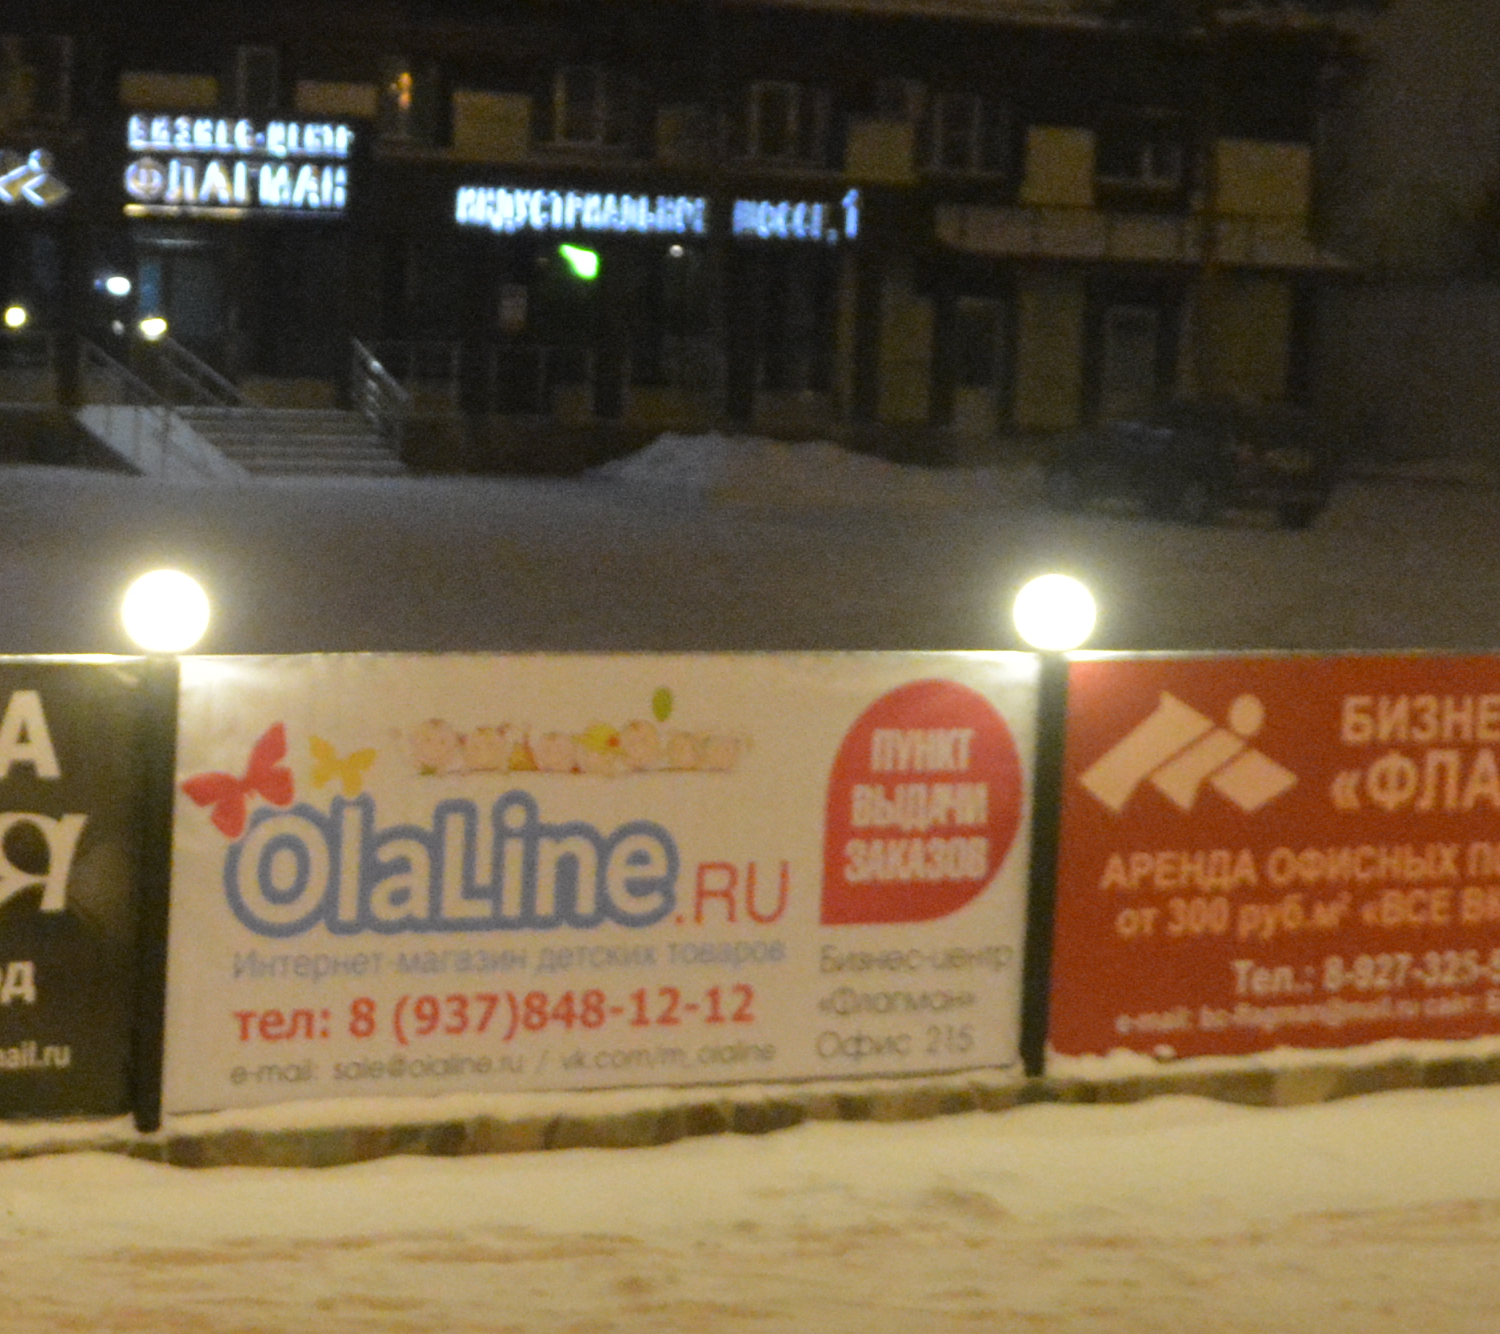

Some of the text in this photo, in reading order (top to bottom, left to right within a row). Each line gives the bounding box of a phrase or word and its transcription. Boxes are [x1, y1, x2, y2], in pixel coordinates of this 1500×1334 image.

[870, 727, 974, 772] ПУНКТ
[850, 781, 990, 831] ВЫДАЧИ
[843, 836, 990, 883] ЗАКАЗОВ
[1099, 849, 1261, 891] АРЕНДА
[1267, 843, 1460, 886] ОФИСНЫХ
[1115, 905, 1161, 938] от
[535, 945, 656, 975] детских
[666, 940, 786, 973] товаров
[231, 983, 756, 1046] тел: 8 (937)848-12-12
[815, 1029, 912, 1062] Офис
